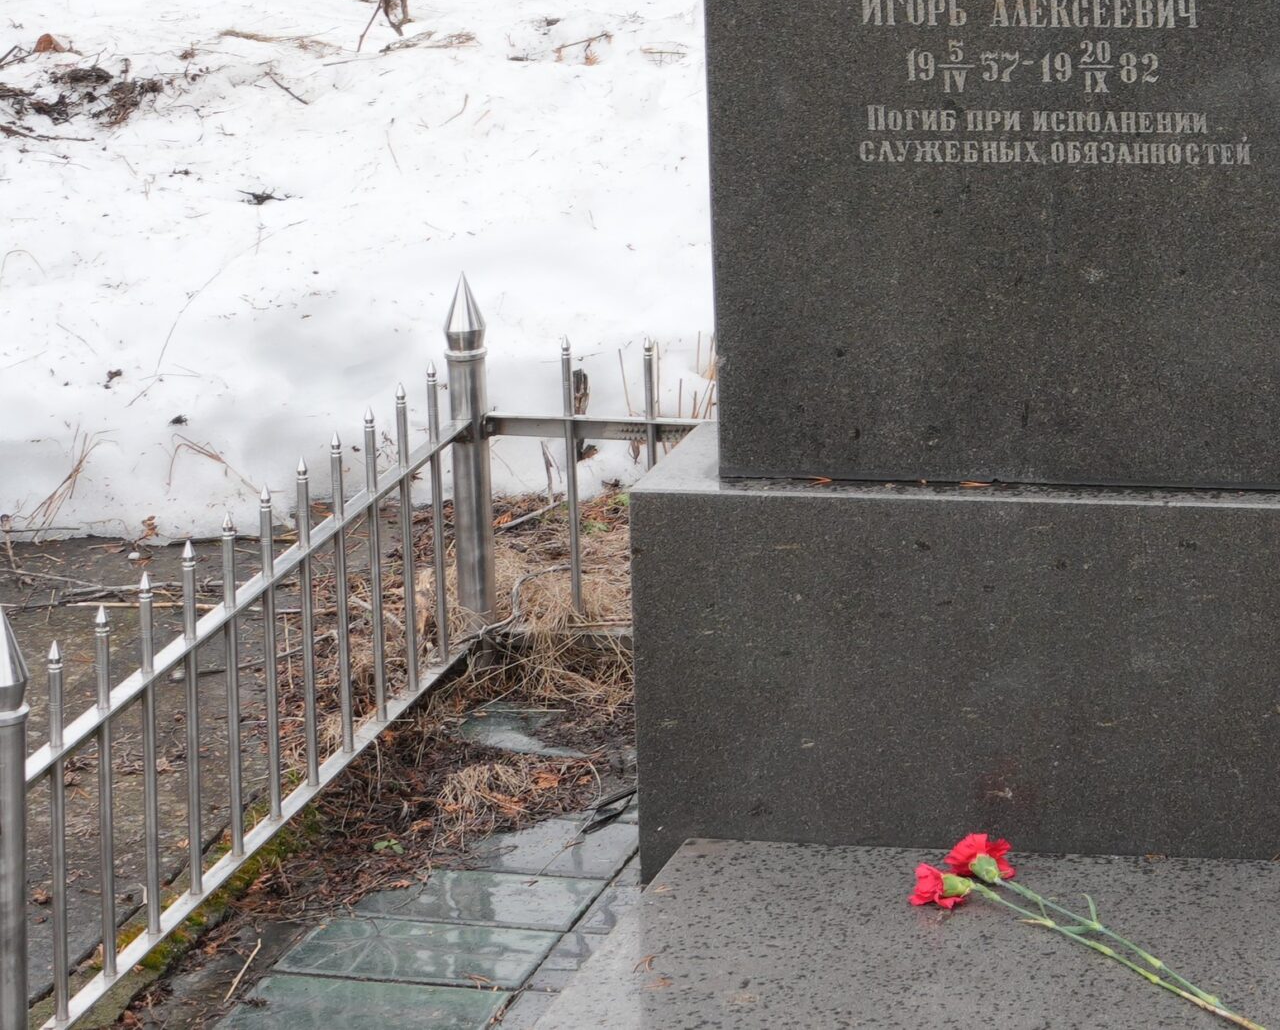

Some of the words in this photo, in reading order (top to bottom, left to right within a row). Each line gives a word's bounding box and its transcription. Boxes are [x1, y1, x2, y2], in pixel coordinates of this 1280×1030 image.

[866, 105, 957, 131] ПОГИБ
[966, 109, 1021, 132] ПРИ
[1032, 109, 1208, 134] ИСПОЛНЕНИИ
[859, 139, 1041, 164] СЛУЖЕБНЫХ
[1051, 134, 1251, 165] ОБЯЗАННОСТЕЙ
